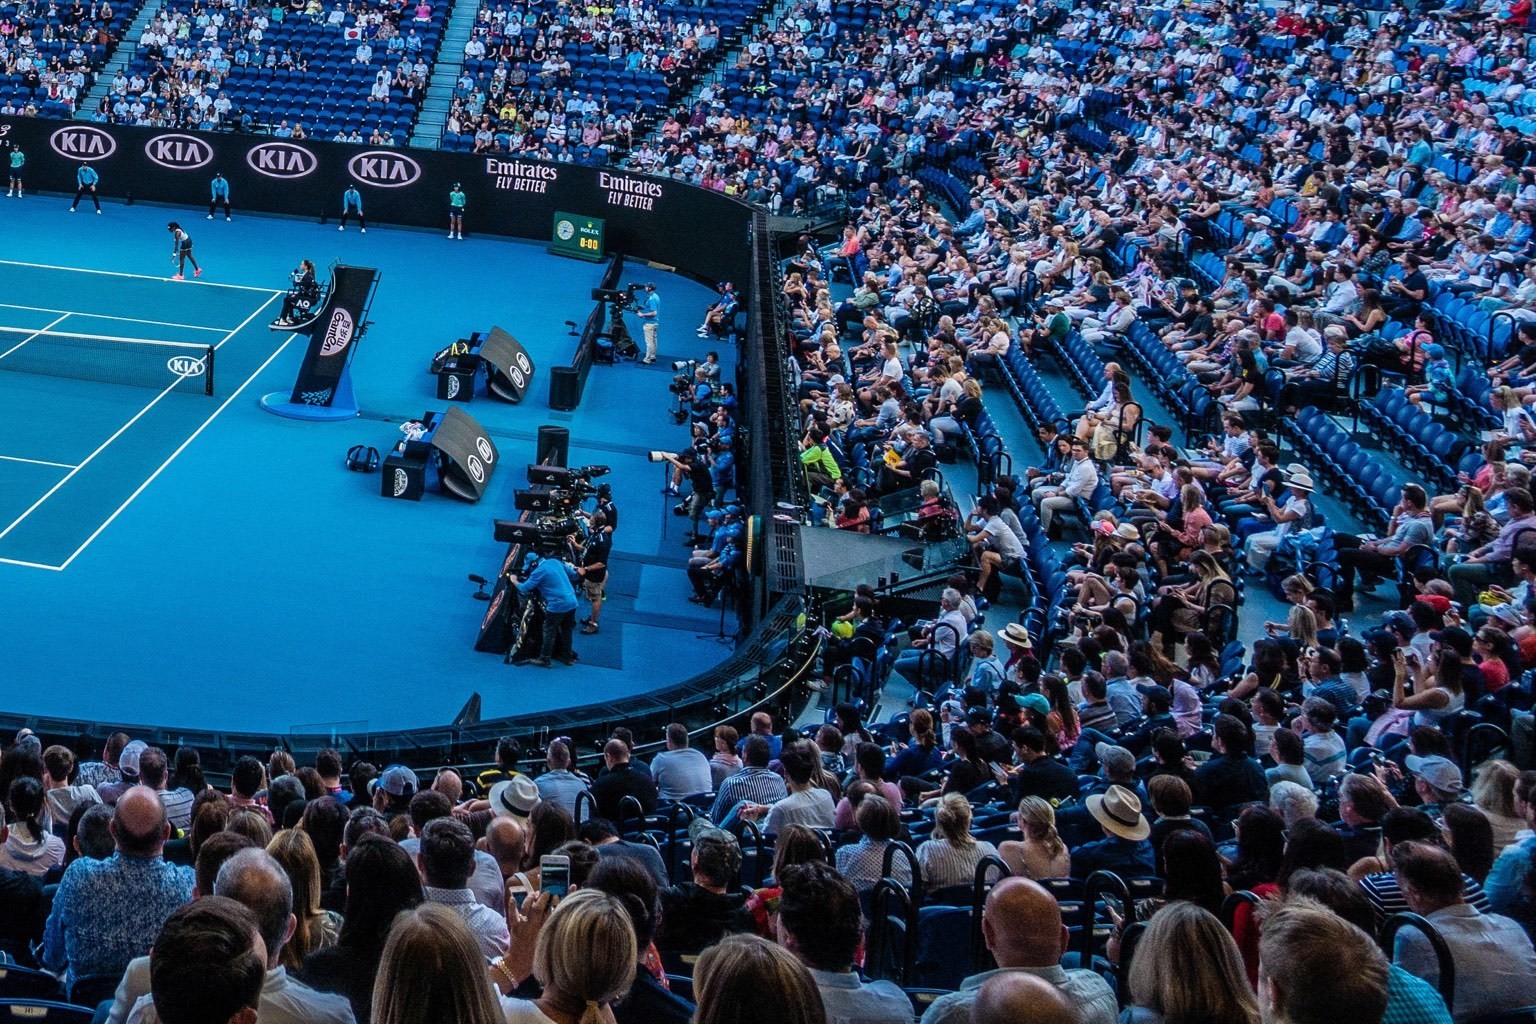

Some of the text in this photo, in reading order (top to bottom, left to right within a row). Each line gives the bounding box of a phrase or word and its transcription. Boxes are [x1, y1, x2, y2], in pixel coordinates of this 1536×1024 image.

[62, 133, 104, 154] KIA
[157, 141, 201, 162] KIA
[259, 149, 305, 171] KIA
[361, 158, 408, 180] KIA
[486, 158, 557, 180] Emirates
[496, 177, 546, 193] FLY BETTER
[600, 172, 662, 197] Emirates
[608, 191, 653, 210] FLY BETTER
[580, 238, 598, 249] 0:00
[296, 299, 310, 307] AO
[174, 360, 199, 372] KIA
